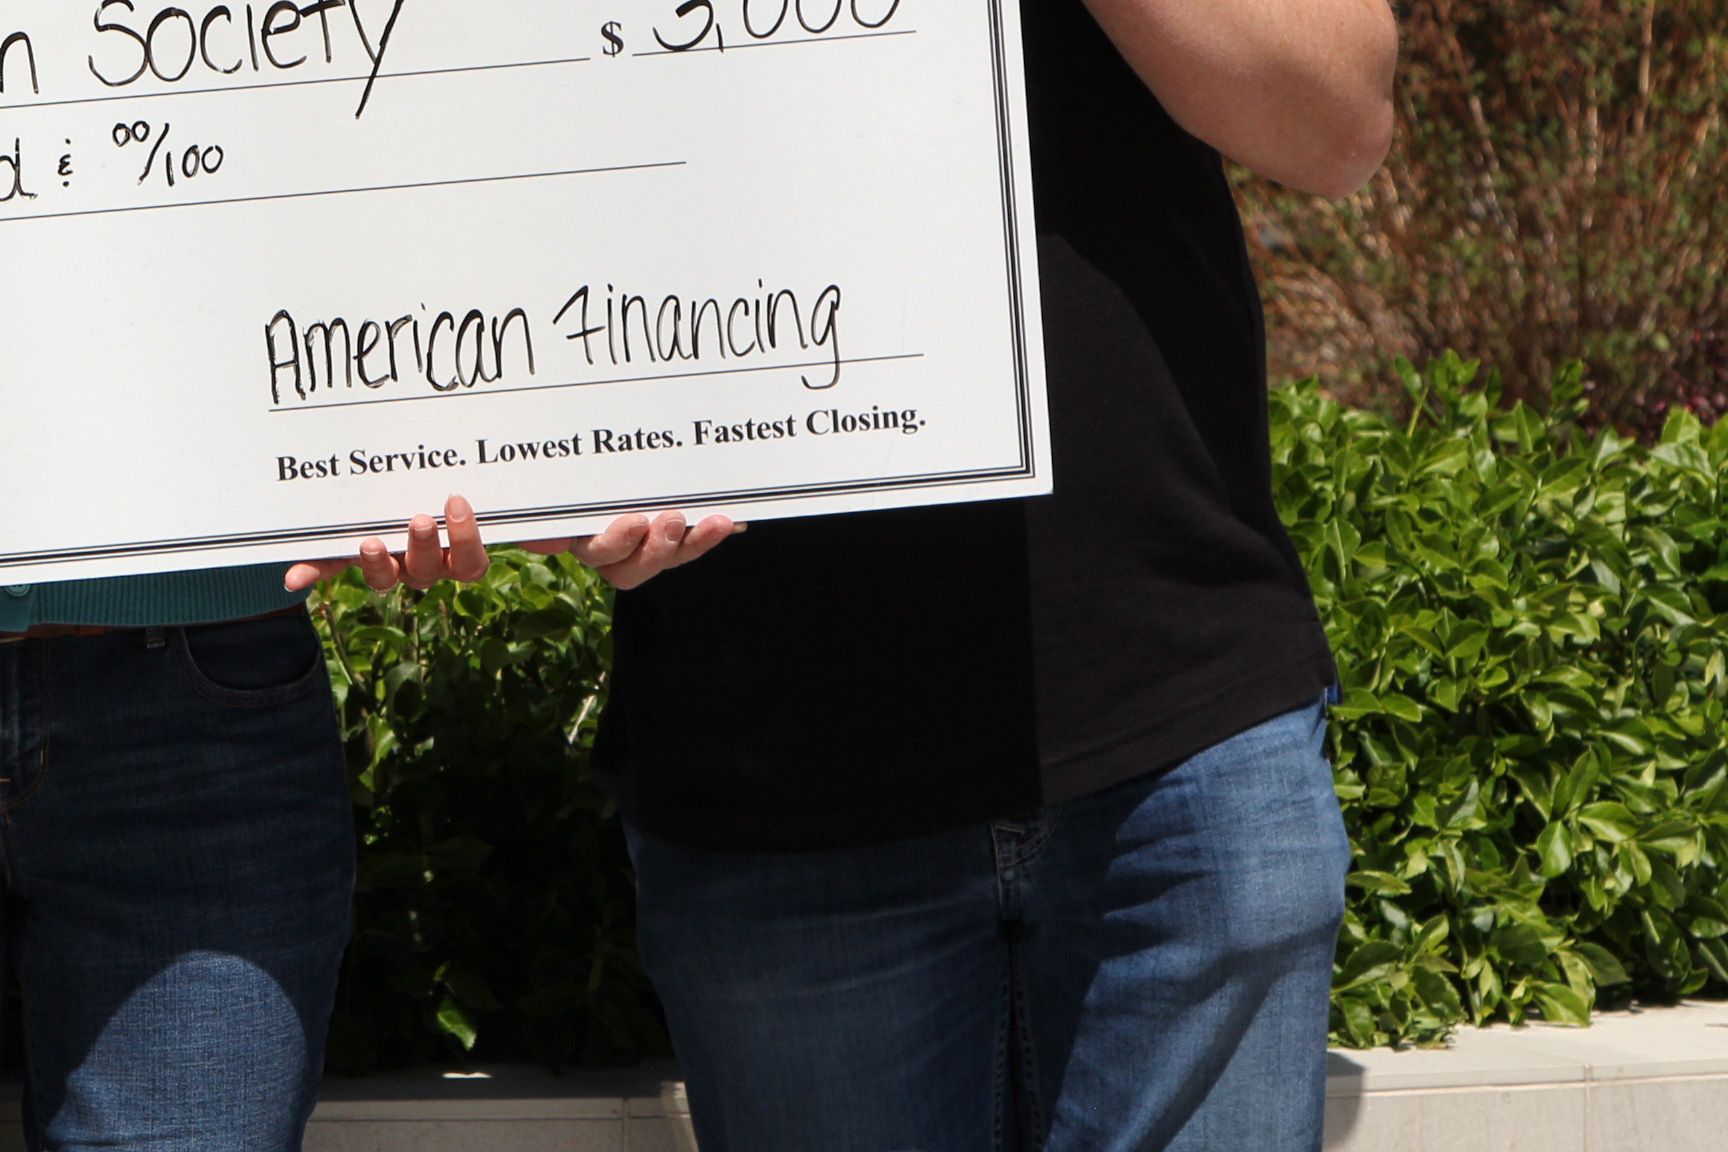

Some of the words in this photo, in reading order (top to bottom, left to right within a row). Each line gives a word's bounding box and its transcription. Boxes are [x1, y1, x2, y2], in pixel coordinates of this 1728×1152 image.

[602, 21, 625, 57] $
[264, 302, 535, 404] American
[553, 278, 841, 390] Financing
[276, 452, 341, 482] Best
[349, 443, 466, 475] Service.
[475, 434, 582, 465] Lowest
[591, 426, 684, 454] Rates.
[693, 414, 797, 445] Fastest
[805, 403, 926, 438] Closing.
